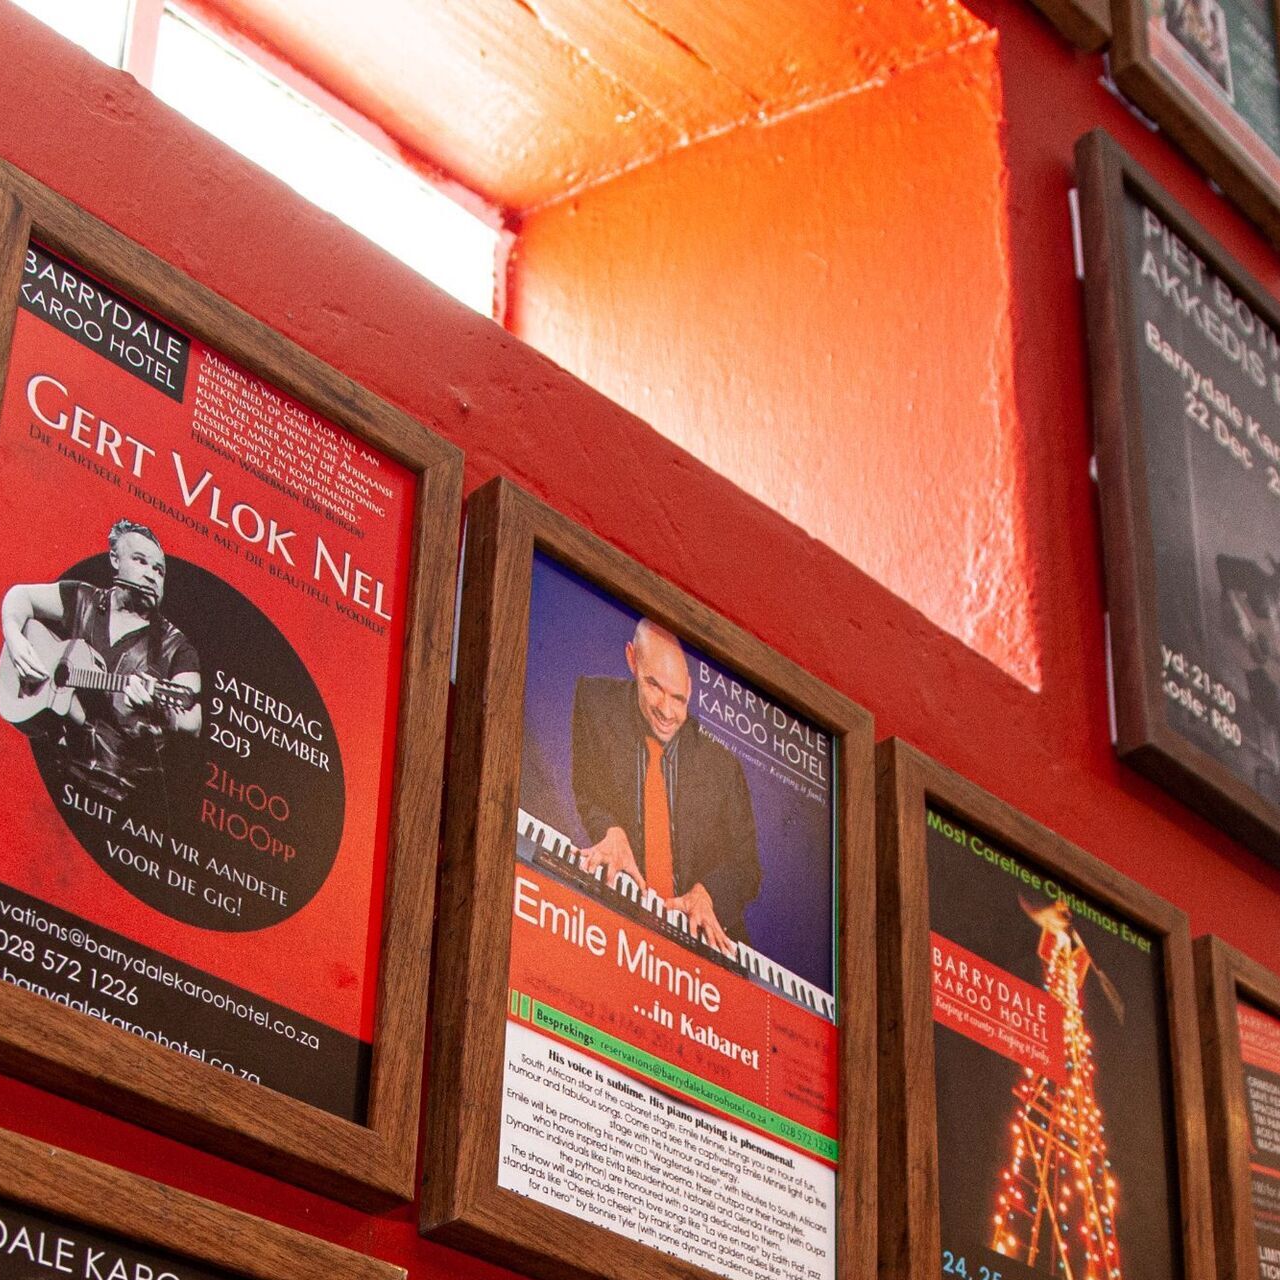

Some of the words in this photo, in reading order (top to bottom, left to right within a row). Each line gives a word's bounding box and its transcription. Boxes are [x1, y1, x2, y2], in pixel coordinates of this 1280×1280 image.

[25, 250, 183, 364] BARRYDALE
[1145, 320, 1243, 429] Barrydale
[261, 388, 282, 405] WAT
[360, 451, 379, 467] AAN
[1214, 416, 1254, 469] Dec
[25, 374, 155, 479] GERT
[172, 449, 297, 568] VLOK
[315, 539, 392, 622] NEL
[210, 722, 251, 760] 2013
[212, 698, 224, 717] 9
[228, 707, 330, 774] NOVEMBER
[214, 670, 324, 743] SATERDAG
[698, 690, 767, 744] KAROO
[773, 735, 826, 781] HOTEL
[700, 661, 826, 754] BARRYDALE
[62, 784, 117, 825] SLUIT
[122, 817, 165, 849] AAN
[171, 838, 200, 867] VIR
[205, 856, 289, 907] AANDETE
[106, 840, 160, 880] VOOR
[168, 868, 197, 896] DIE
[203, 887, 242, 917] GIG!
[42, 949, 82, 983] 572
[90, 967, 139, 1006] 1226
[514, 877, 607, 956] Emile
[618, 929, 721, 1013] Minnie
[932, 947, 1047, 1024] BARRYDALE
[934, 972, 992, 1012] KAROO
[1000, 1006, 1048, 1043] HOTEL
[679, 1012, 760, 1071] Kabaret
